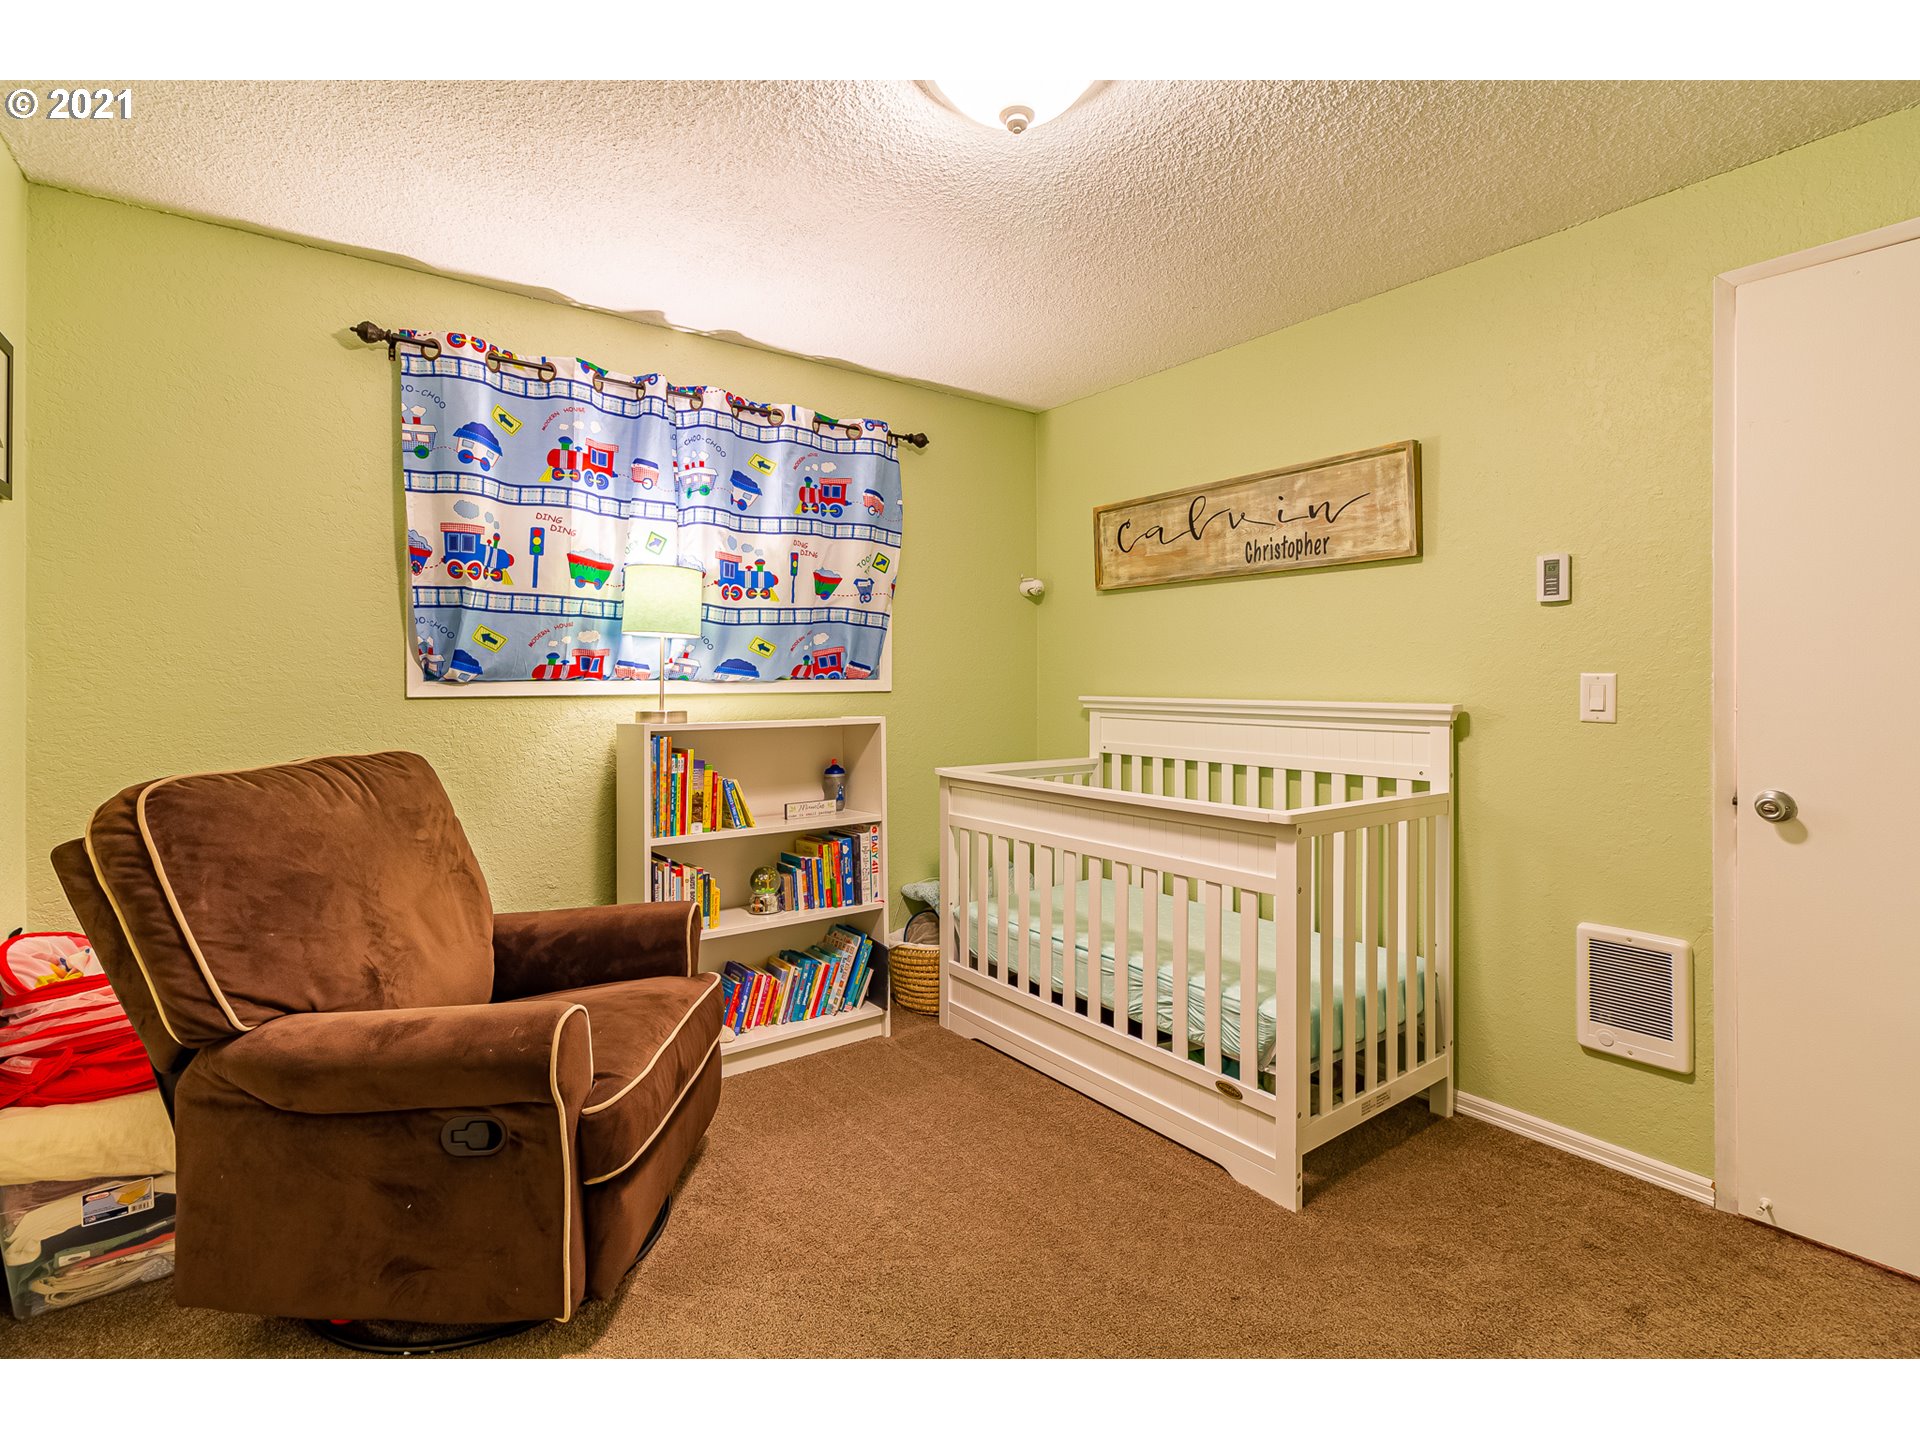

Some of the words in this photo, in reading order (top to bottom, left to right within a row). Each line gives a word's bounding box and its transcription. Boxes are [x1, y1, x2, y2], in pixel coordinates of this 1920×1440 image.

[535, 512, 563, 524] DING
[550, 524, 576, 537] DING
[1245, 532, 1330, 564] Christopher
[528, 628, 550, 648] MODERN
[871, 836, 879, 859] BABY
[871, 860, 879, 874] 411
